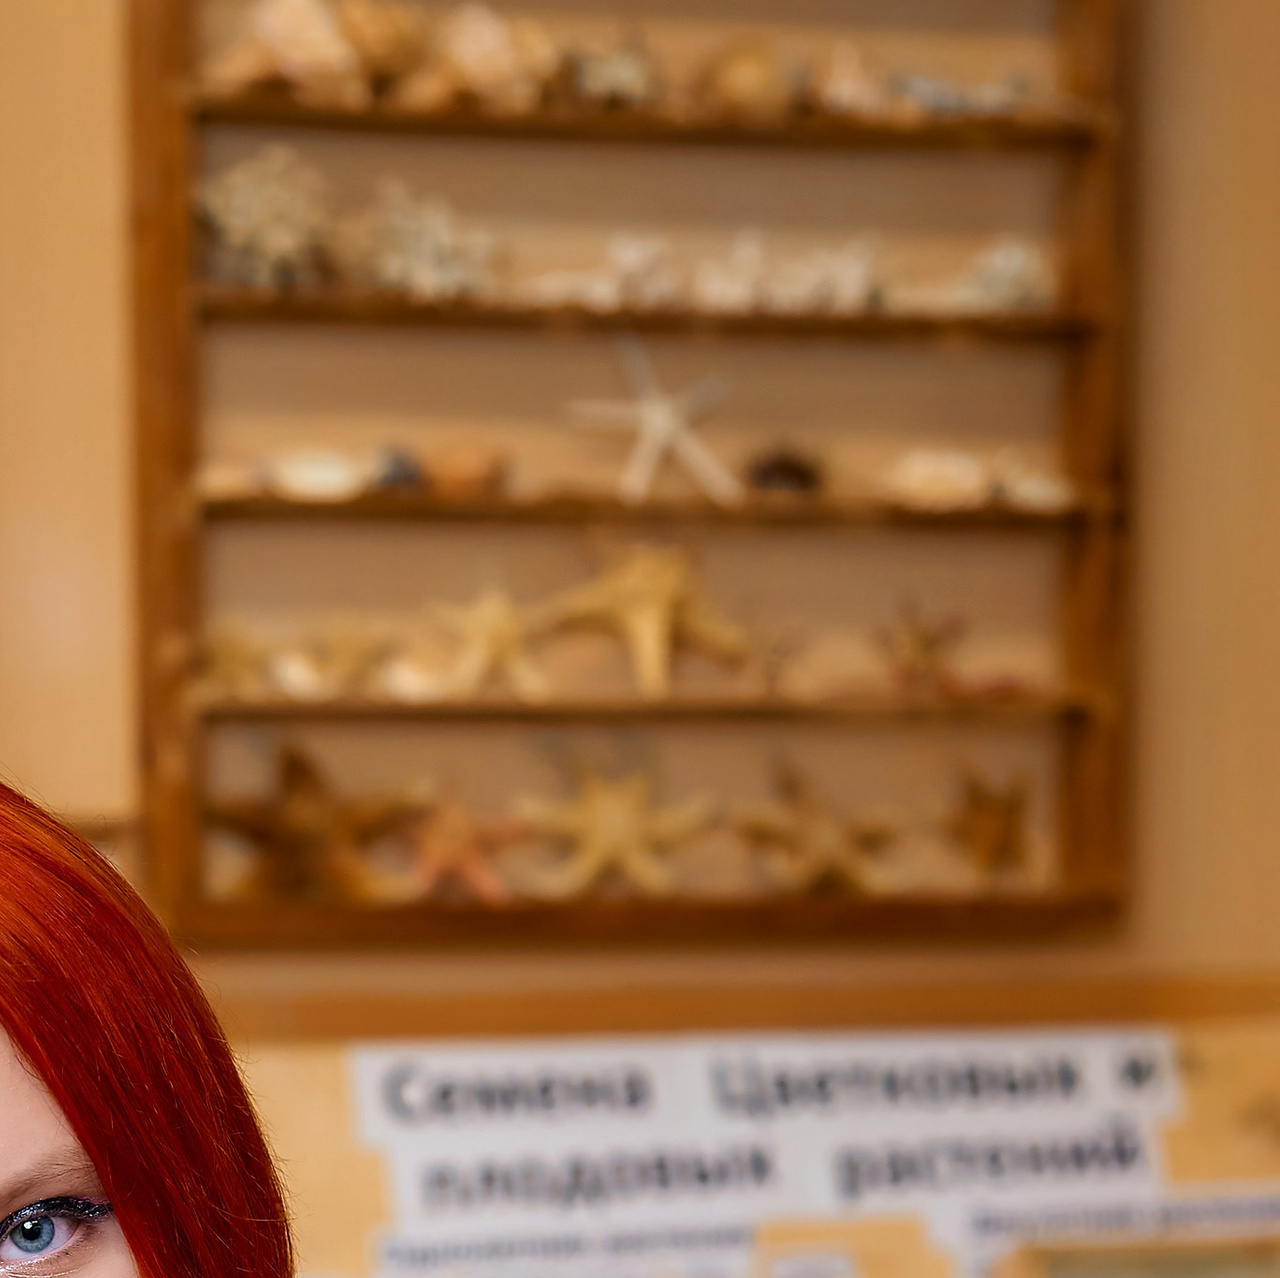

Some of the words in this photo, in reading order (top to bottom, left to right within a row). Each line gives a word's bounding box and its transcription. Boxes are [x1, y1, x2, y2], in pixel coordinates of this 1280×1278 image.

[382, 1063, 651, 1122] Семена
[1119, 1051, 1157, 1093] и
[425, 1145, 774, 1211] плодовых
[836, 1119, 1144, 1201] растений
